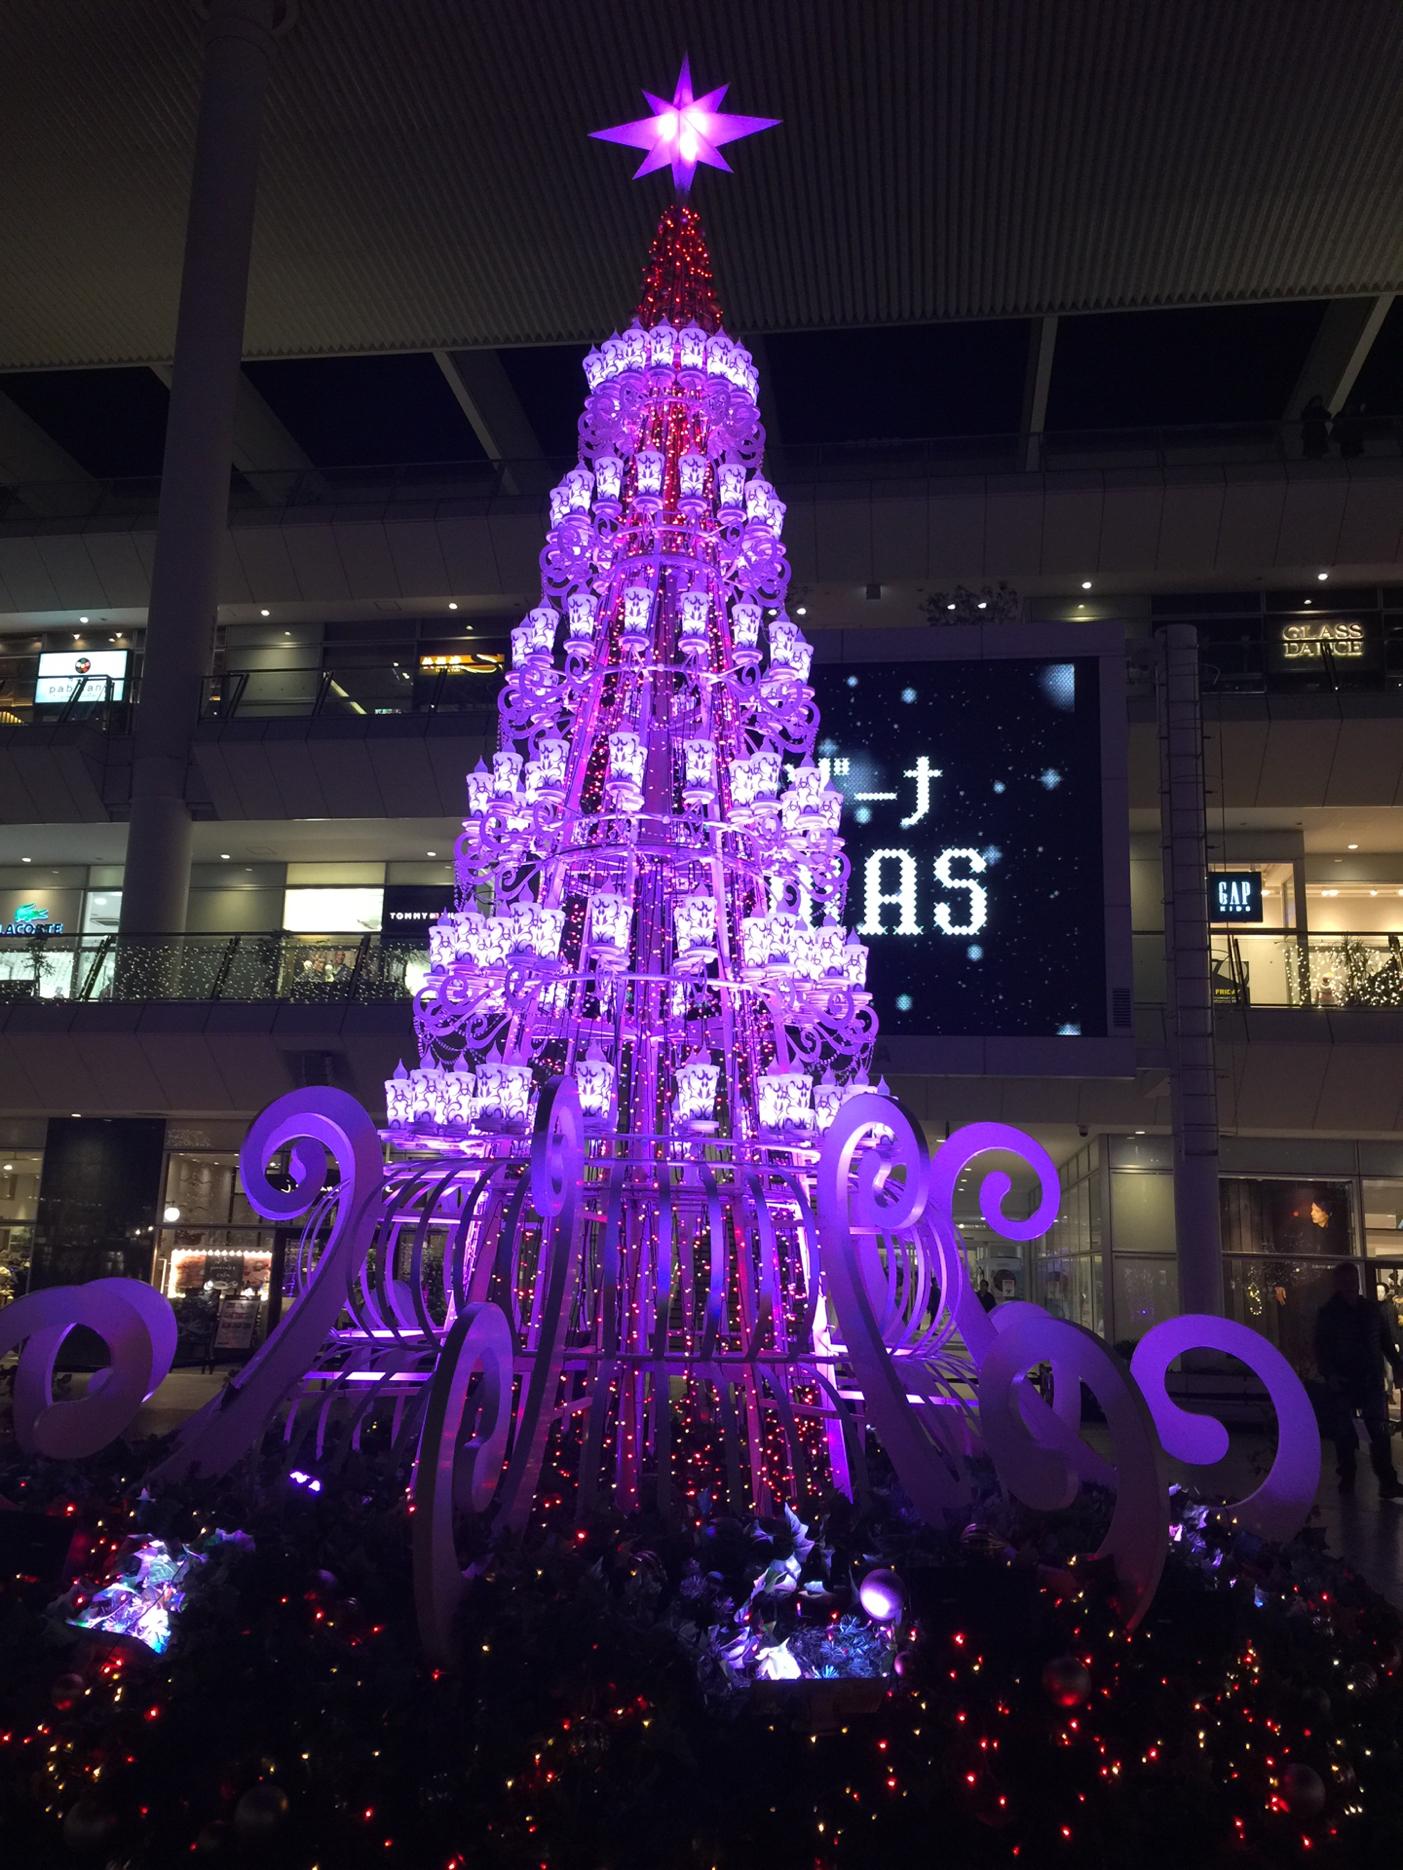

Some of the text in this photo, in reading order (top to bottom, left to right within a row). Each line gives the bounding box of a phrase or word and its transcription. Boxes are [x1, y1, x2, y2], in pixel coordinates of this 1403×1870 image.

[1283, 624, 1363, 640] GLASS
[1284, 641, 1362, 656] DANCE
[1218, 881, 1251, 905] GAP
[389, 912, 428, 920] TOMMY
